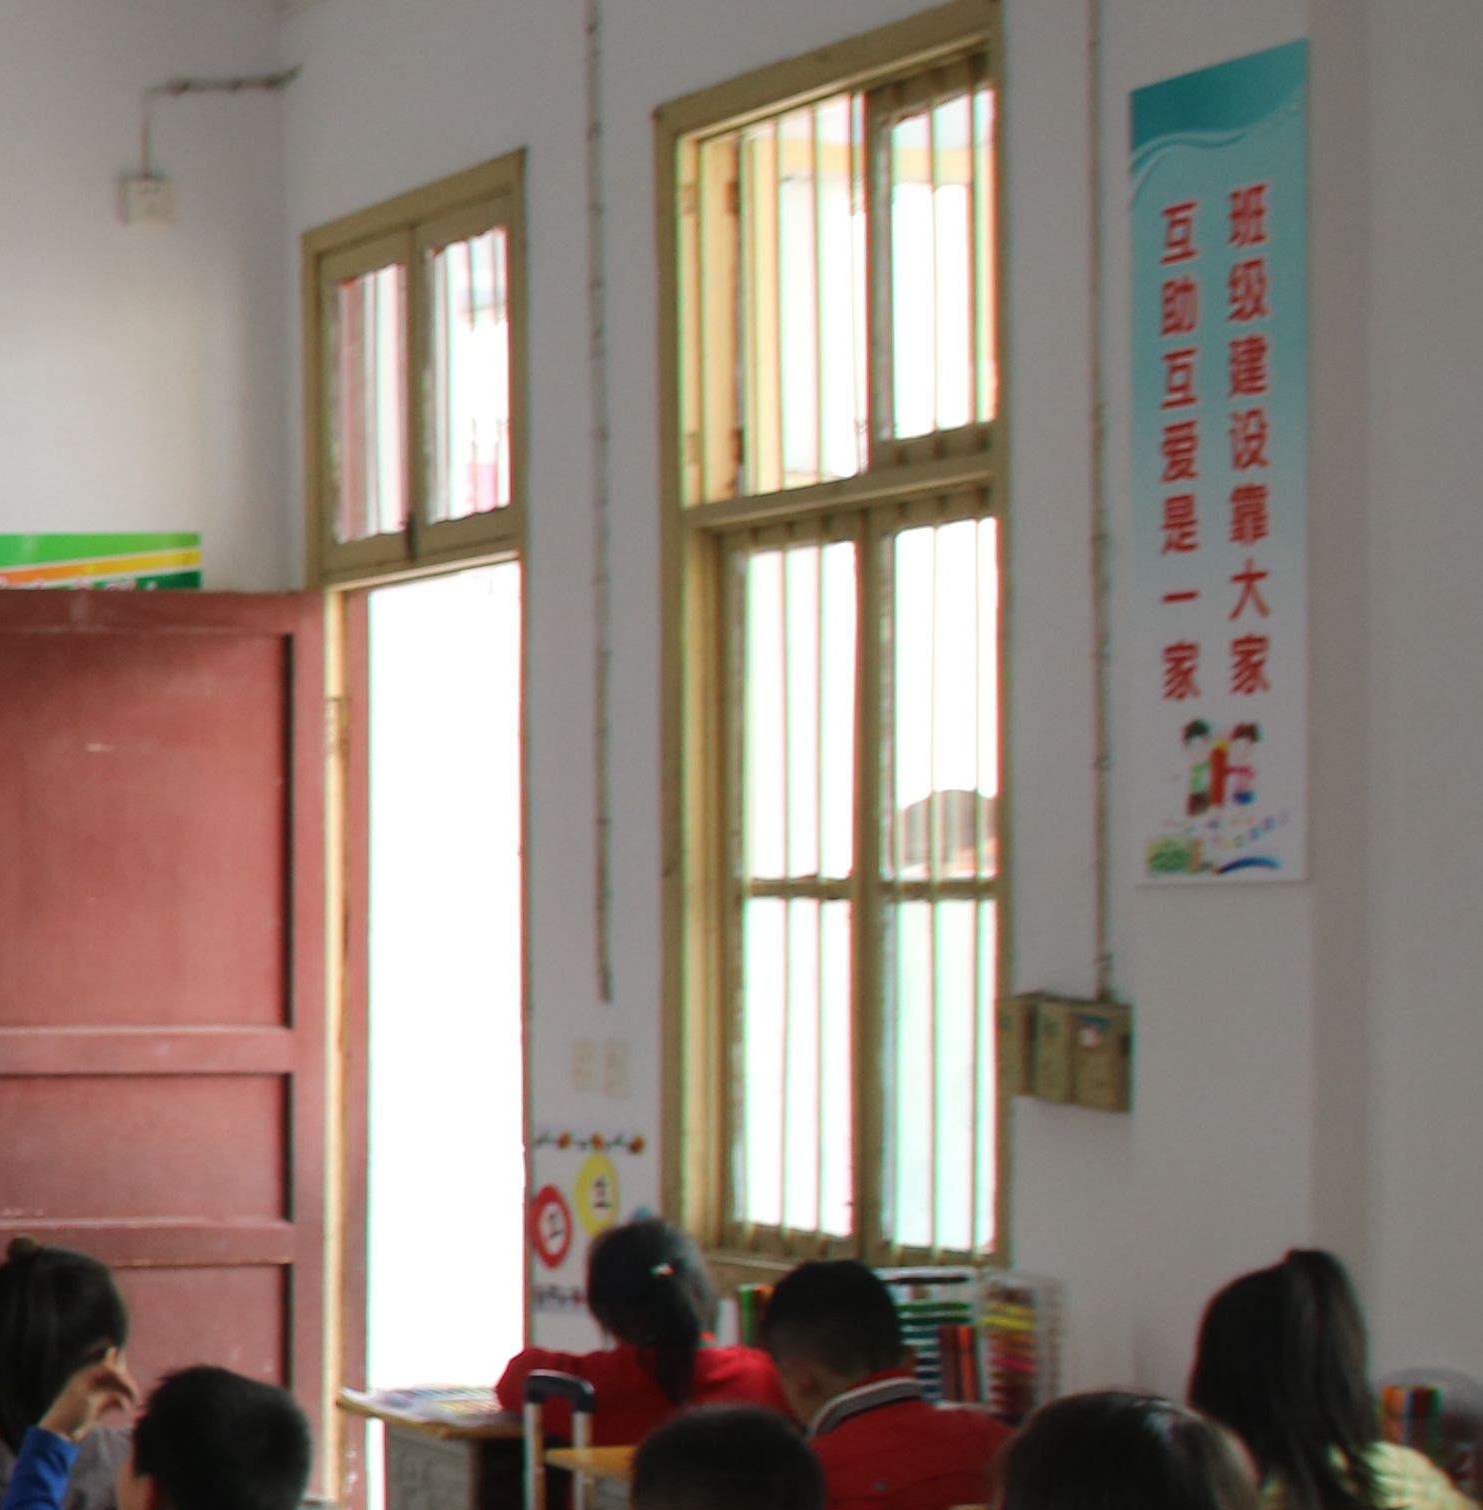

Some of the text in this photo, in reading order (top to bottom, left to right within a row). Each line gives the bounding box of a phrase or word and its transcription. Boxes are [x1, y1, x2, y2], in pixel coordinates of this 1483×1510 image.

[1160, 202, 1199, 701] 互助互爱是一家
[1228, 184, 1269, 697] 班级建设靠大家
